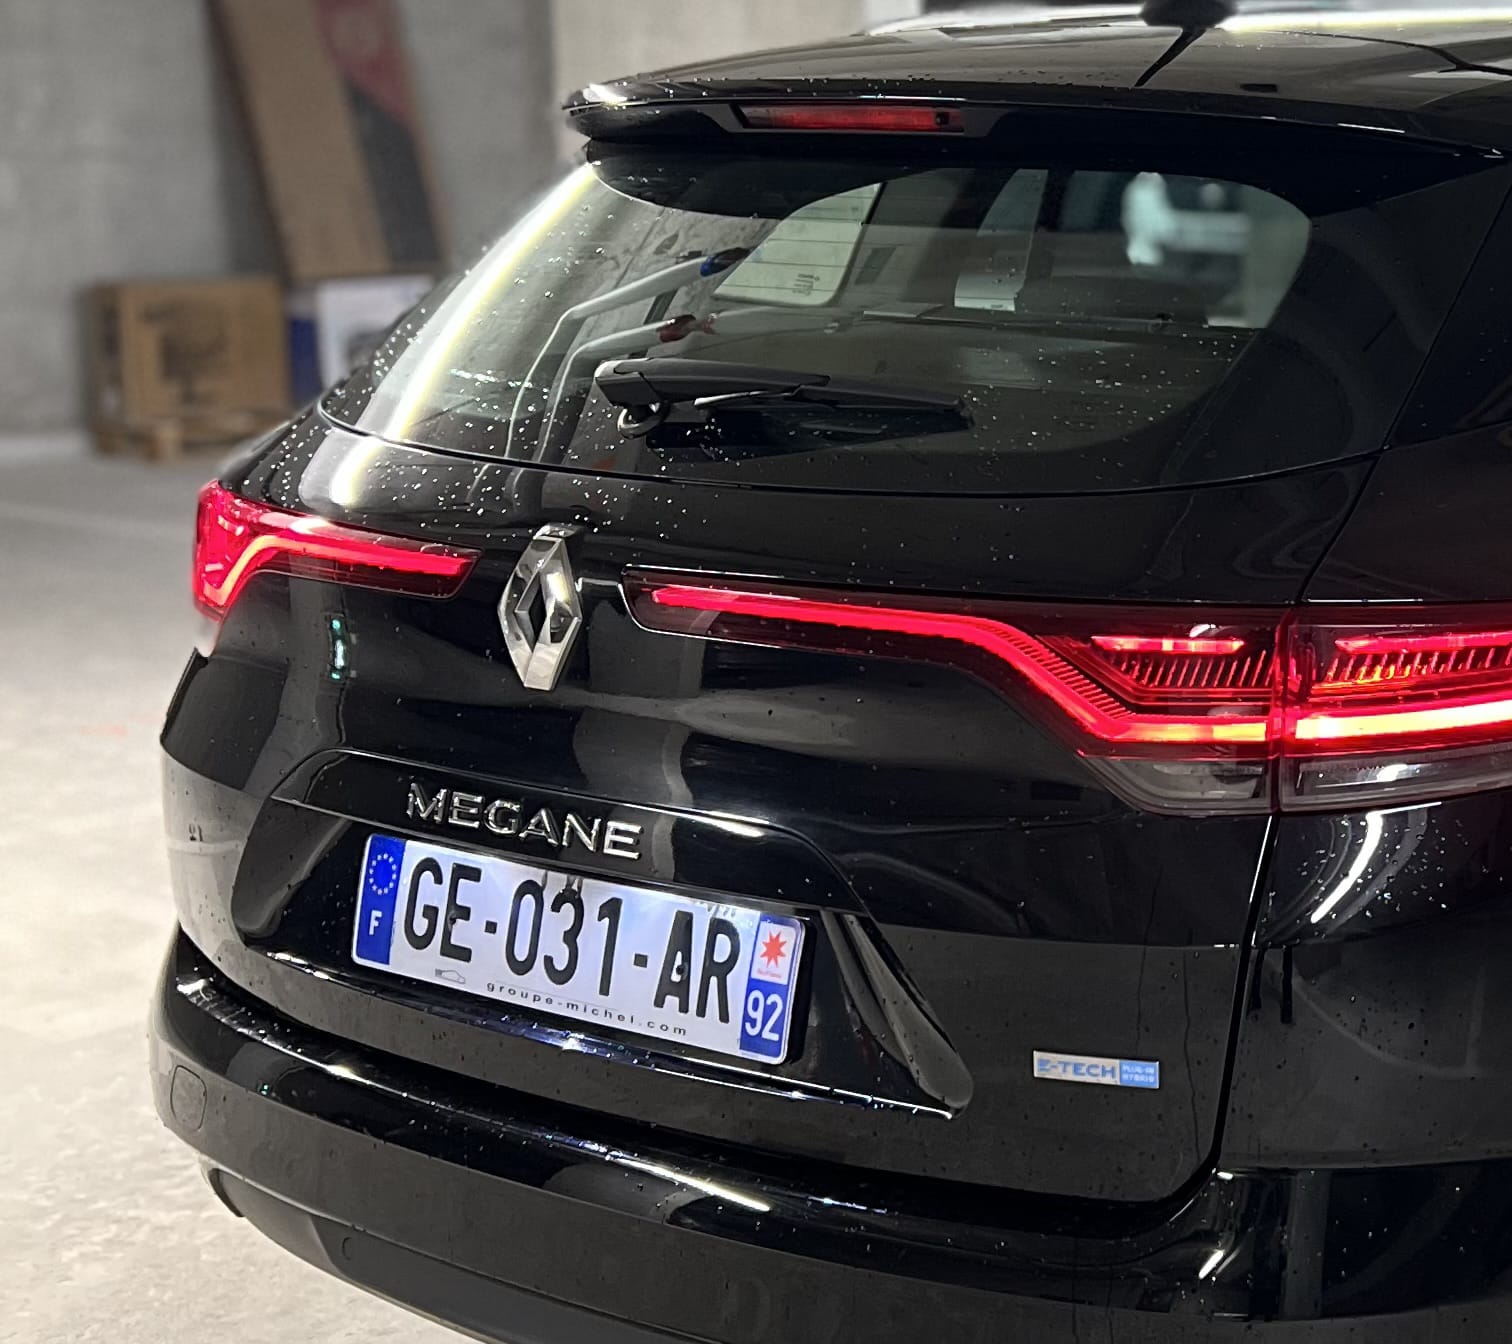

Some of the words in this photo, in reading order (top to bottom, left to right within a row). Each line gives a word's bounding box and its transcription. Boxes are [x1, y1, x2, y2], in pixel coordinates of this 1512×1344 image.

[407, 783, 643, 860] MEGANE
[368, 909, 383, 936] F
[403, 857, 741, 1024] GE-031-AR
[486, 981, 688, 1036] groupe-michel.com
[744, 989, 784, 1042] 92
[1036, 1058, 1117, 1079] E-TECH
